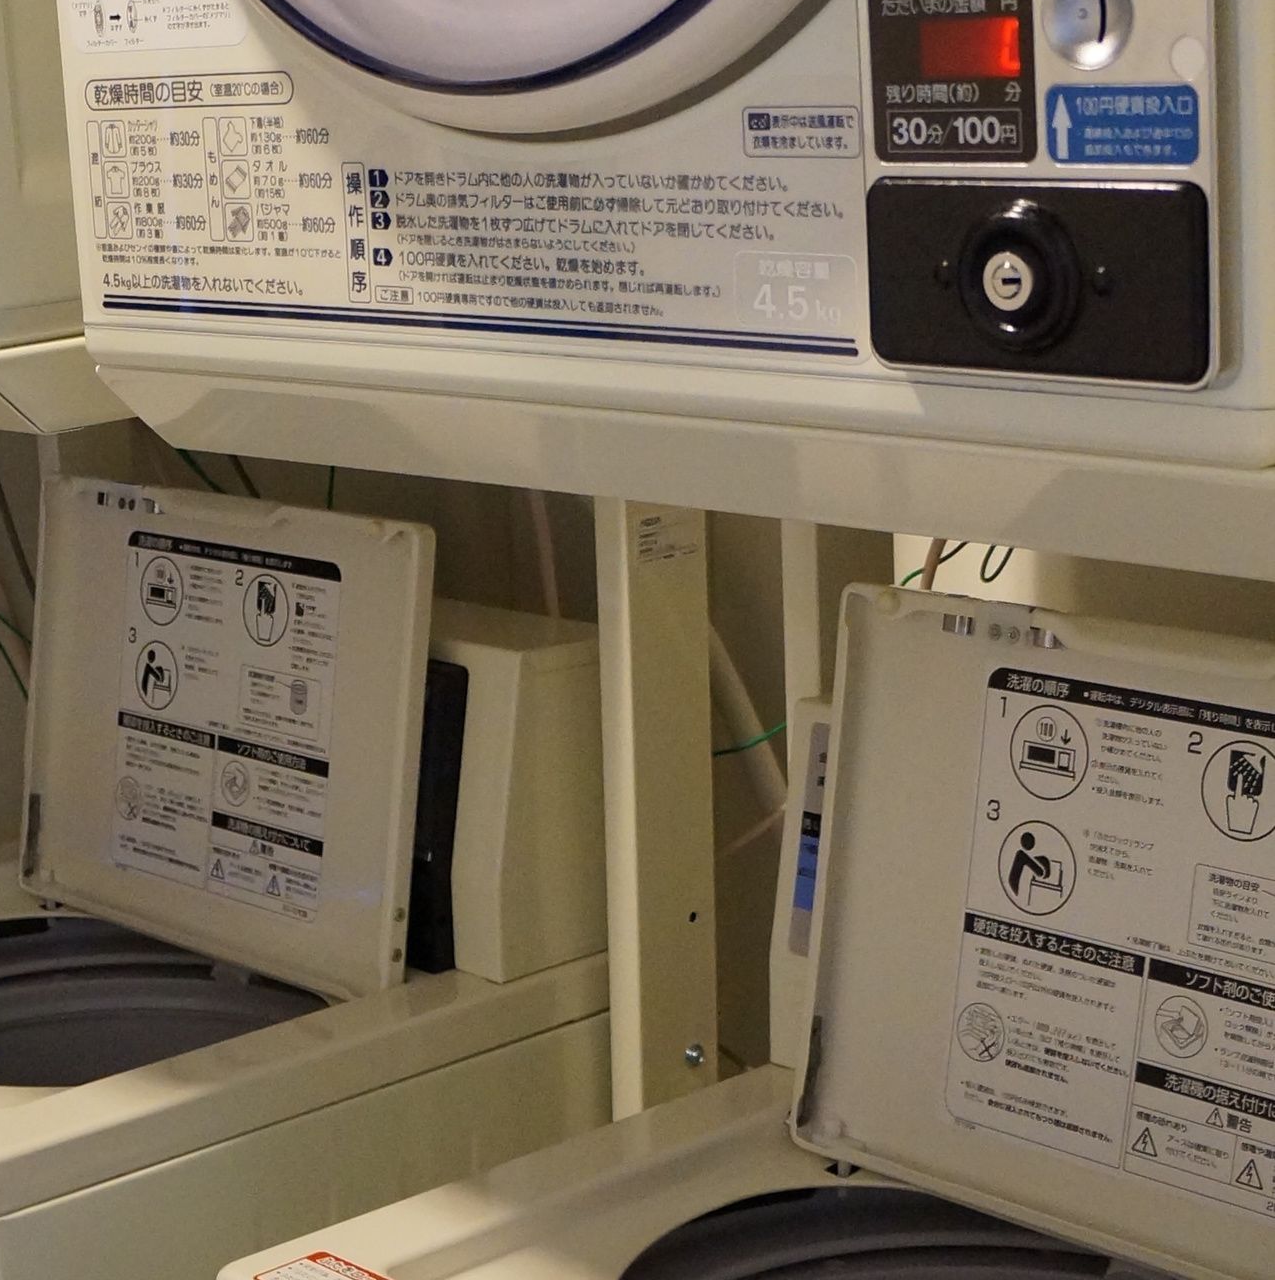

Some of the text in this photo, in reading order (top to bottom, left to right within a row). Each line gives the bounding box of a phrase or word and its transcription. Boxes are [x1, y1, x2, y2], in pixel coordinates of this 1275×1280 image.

[94, 80, 204, 106] 乾燥時間の目安
[886, 81, 1021, 104] 残り時間(約) 分
[1076, 95, 1194, 116] 100円硬貨投入口
[169, 131, 200, 147] 約30分
[295, 128, 330, 145] 約60分
[892, 115, 1017, 145] 30分/100円
[130, 161, 163, 174] ブラウス
[172, 173, 203, 189] 約30分
[299, 173, 333, 189] 約60分
[373, 170, 789, 193] 1 ドアを開きドラム内に他の人の洗濯物が入っていないか確かめてください。
[374, 191, 384, 207] 2
[256, 203, 291, 216] パジャマ
[175, 215, 206, 231] 約60分
[302, 216, 336, 233] 約60分
[375, 213, 385, 229] 3
[346, 172, 367, 295] 操作順序
[376, 249, 387, 266] 4
[102, 272, 304, 297] 4.5kg以上の洗濯物を入れないでください。
[380, 289, 410, 302] ご注意
[753, 283, 842, 323] 4.5 kg
[235, 570, 244, 586] 2
[128, 627, 137, 643] 3
[1007, 673, 1069, 698] 洗濯の順序
[1000, 696, 1007, 718] 1
[1187, 731, 1203, 754] 2
[986, 799, 1000, 820] 3
[1209, 872, 1260, 892] 洗濯物の目安
[973, 917, 1135, 973] 硬貨を投入するときのご注意
